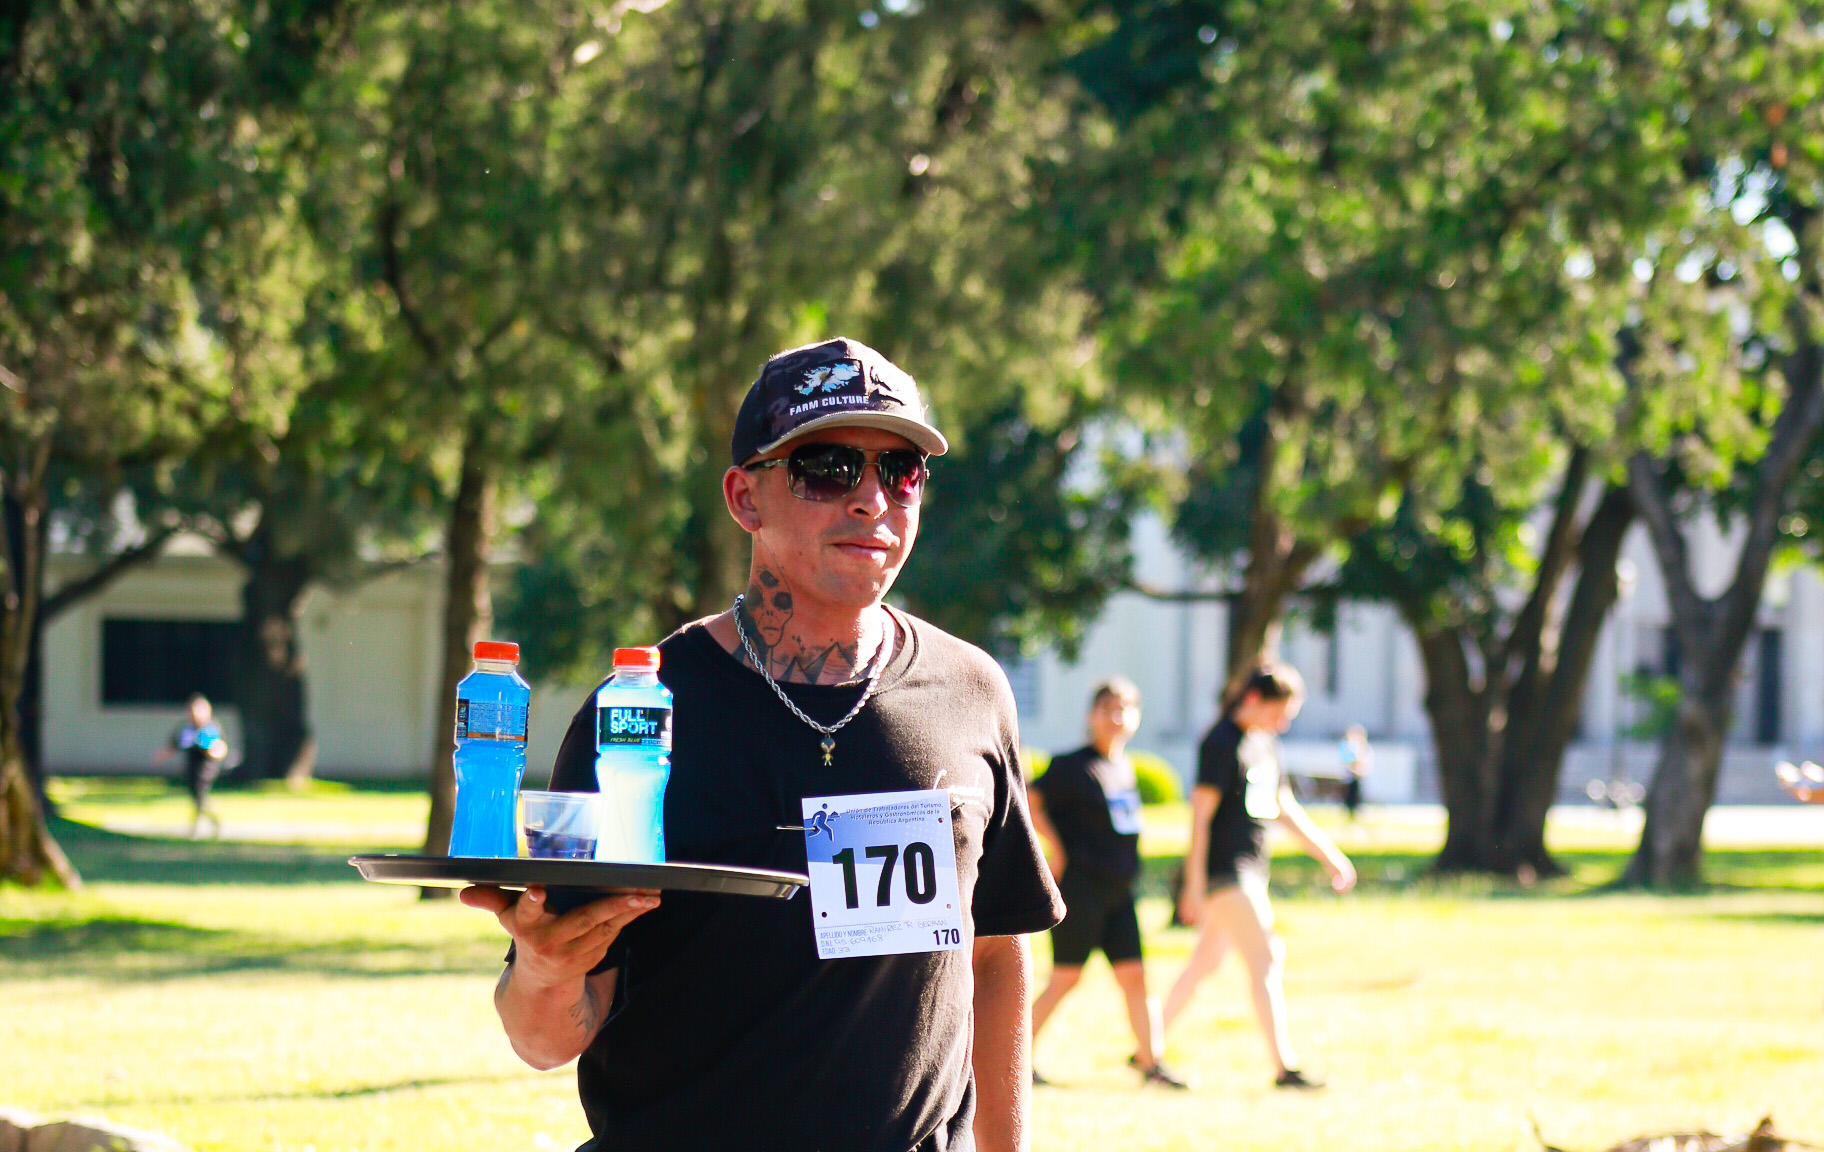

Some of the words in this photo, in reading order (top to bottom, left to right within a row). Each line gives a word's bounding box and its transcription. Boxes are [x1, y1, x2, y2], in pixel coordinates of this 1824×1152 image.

[789, 400, 819, 416] FARM
[821, 395, 869, 407] CULTURE
[611, 709, 645, 721] FULL
[611, 721, 658, 734] SPORT
[832, 842, 937, 909] 170
[933, 928, 960, 946] 170
